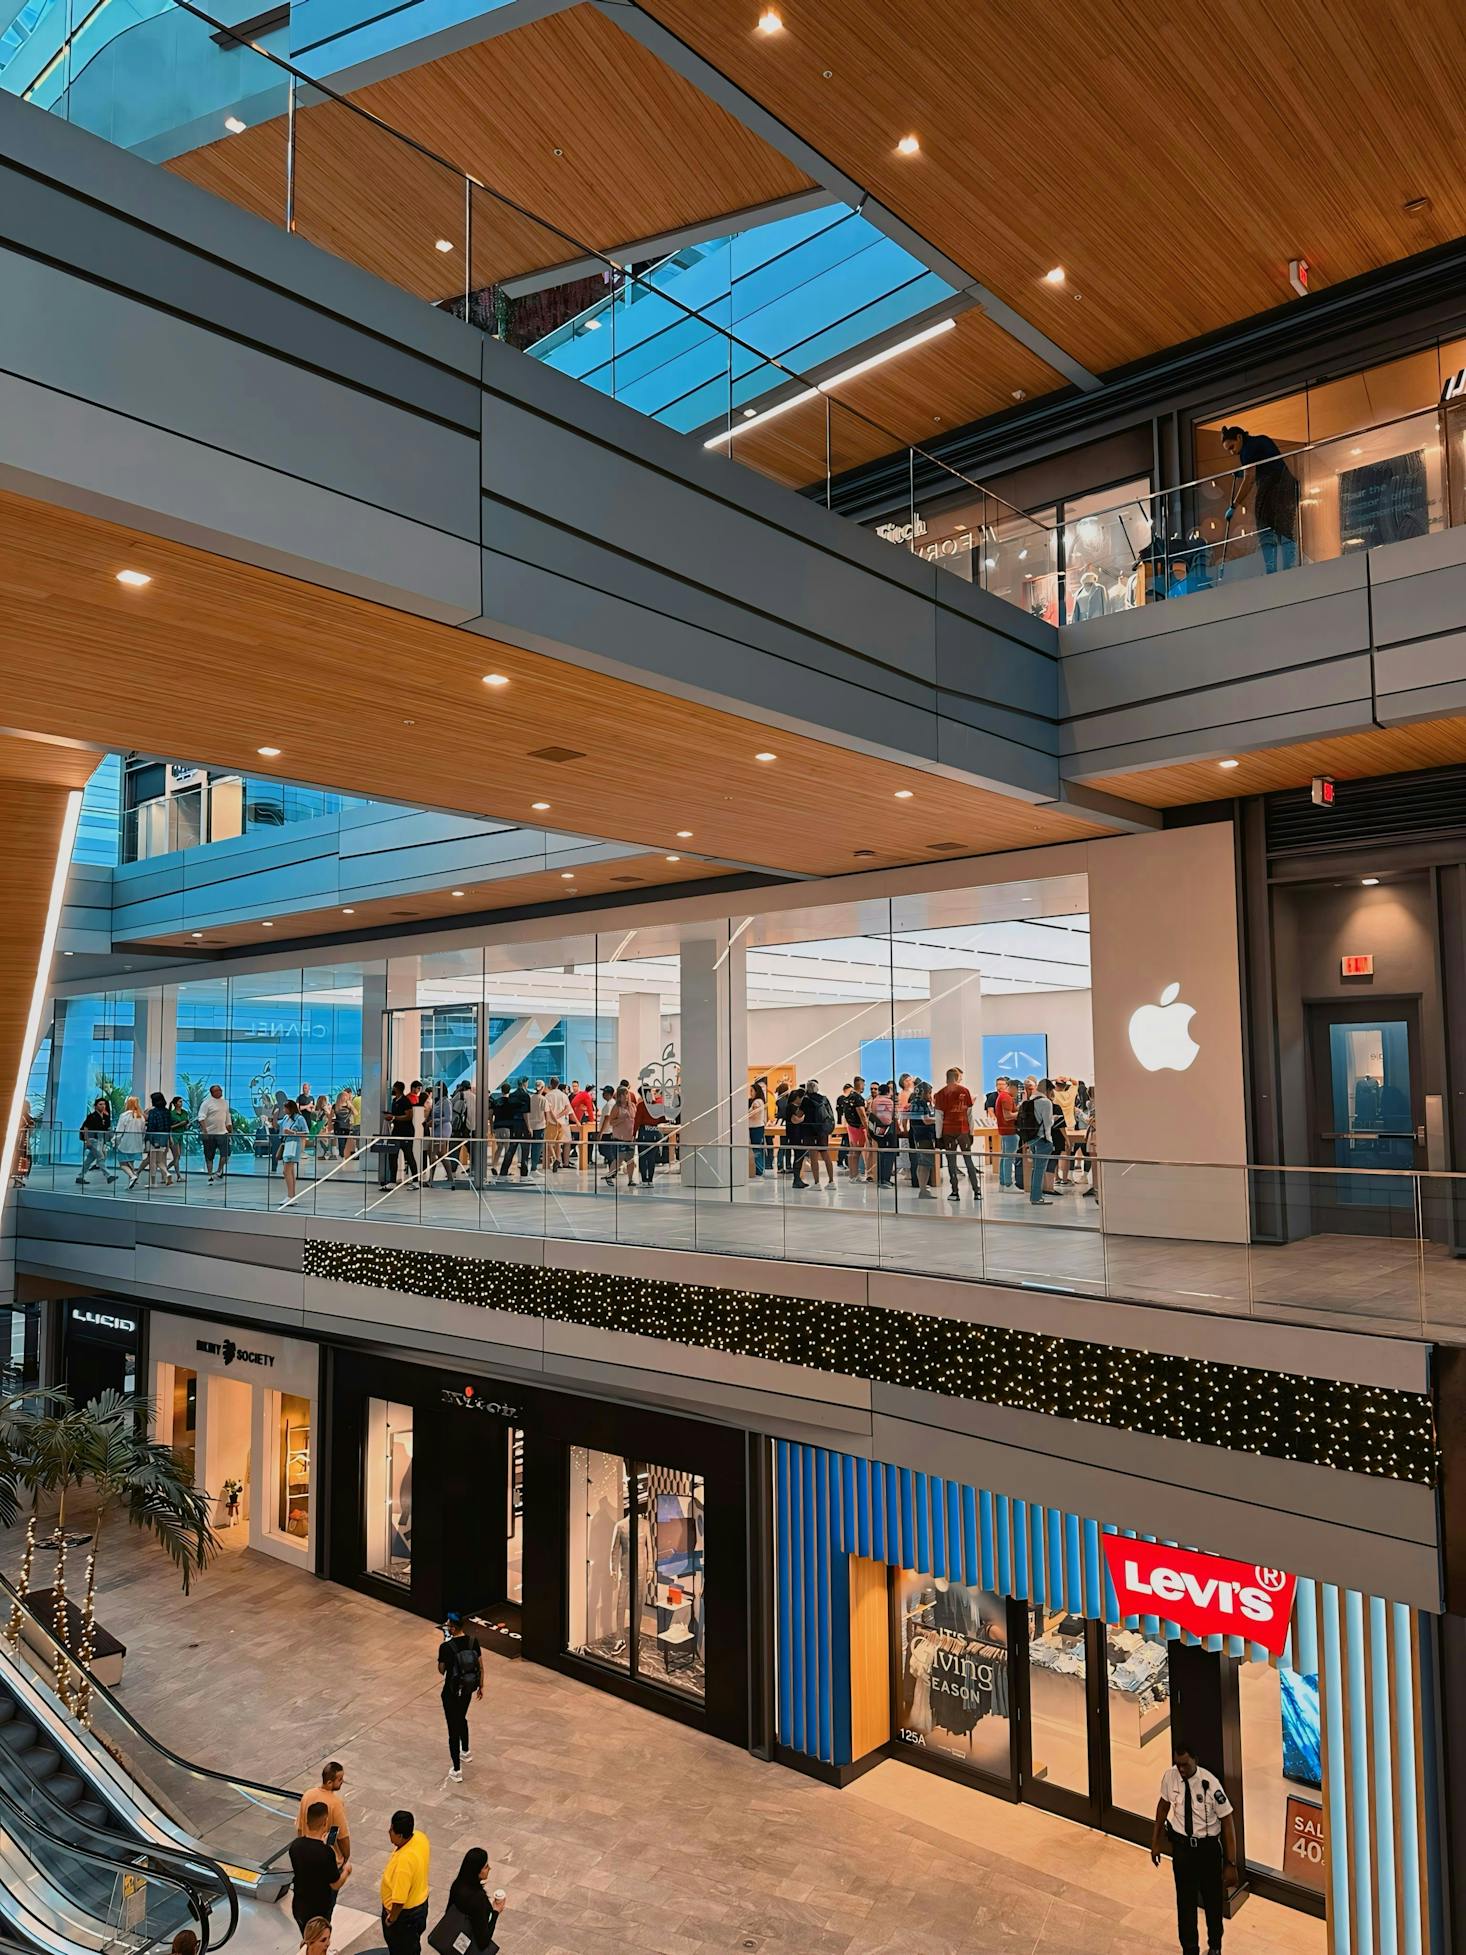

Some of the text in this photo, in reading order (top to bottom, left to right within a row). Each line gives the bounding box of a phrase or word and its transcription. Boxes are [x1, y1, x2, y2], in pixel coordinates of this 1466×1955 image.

[72, 1308, 136, 1332] LUCID
[236, 1348, 275, 1367] SOCIETY
[900, 1728, 926, 1747] 125A
[1294, 1816, 1325, 1839] SAL
[1291, 1837, 1325, 1864] 40
